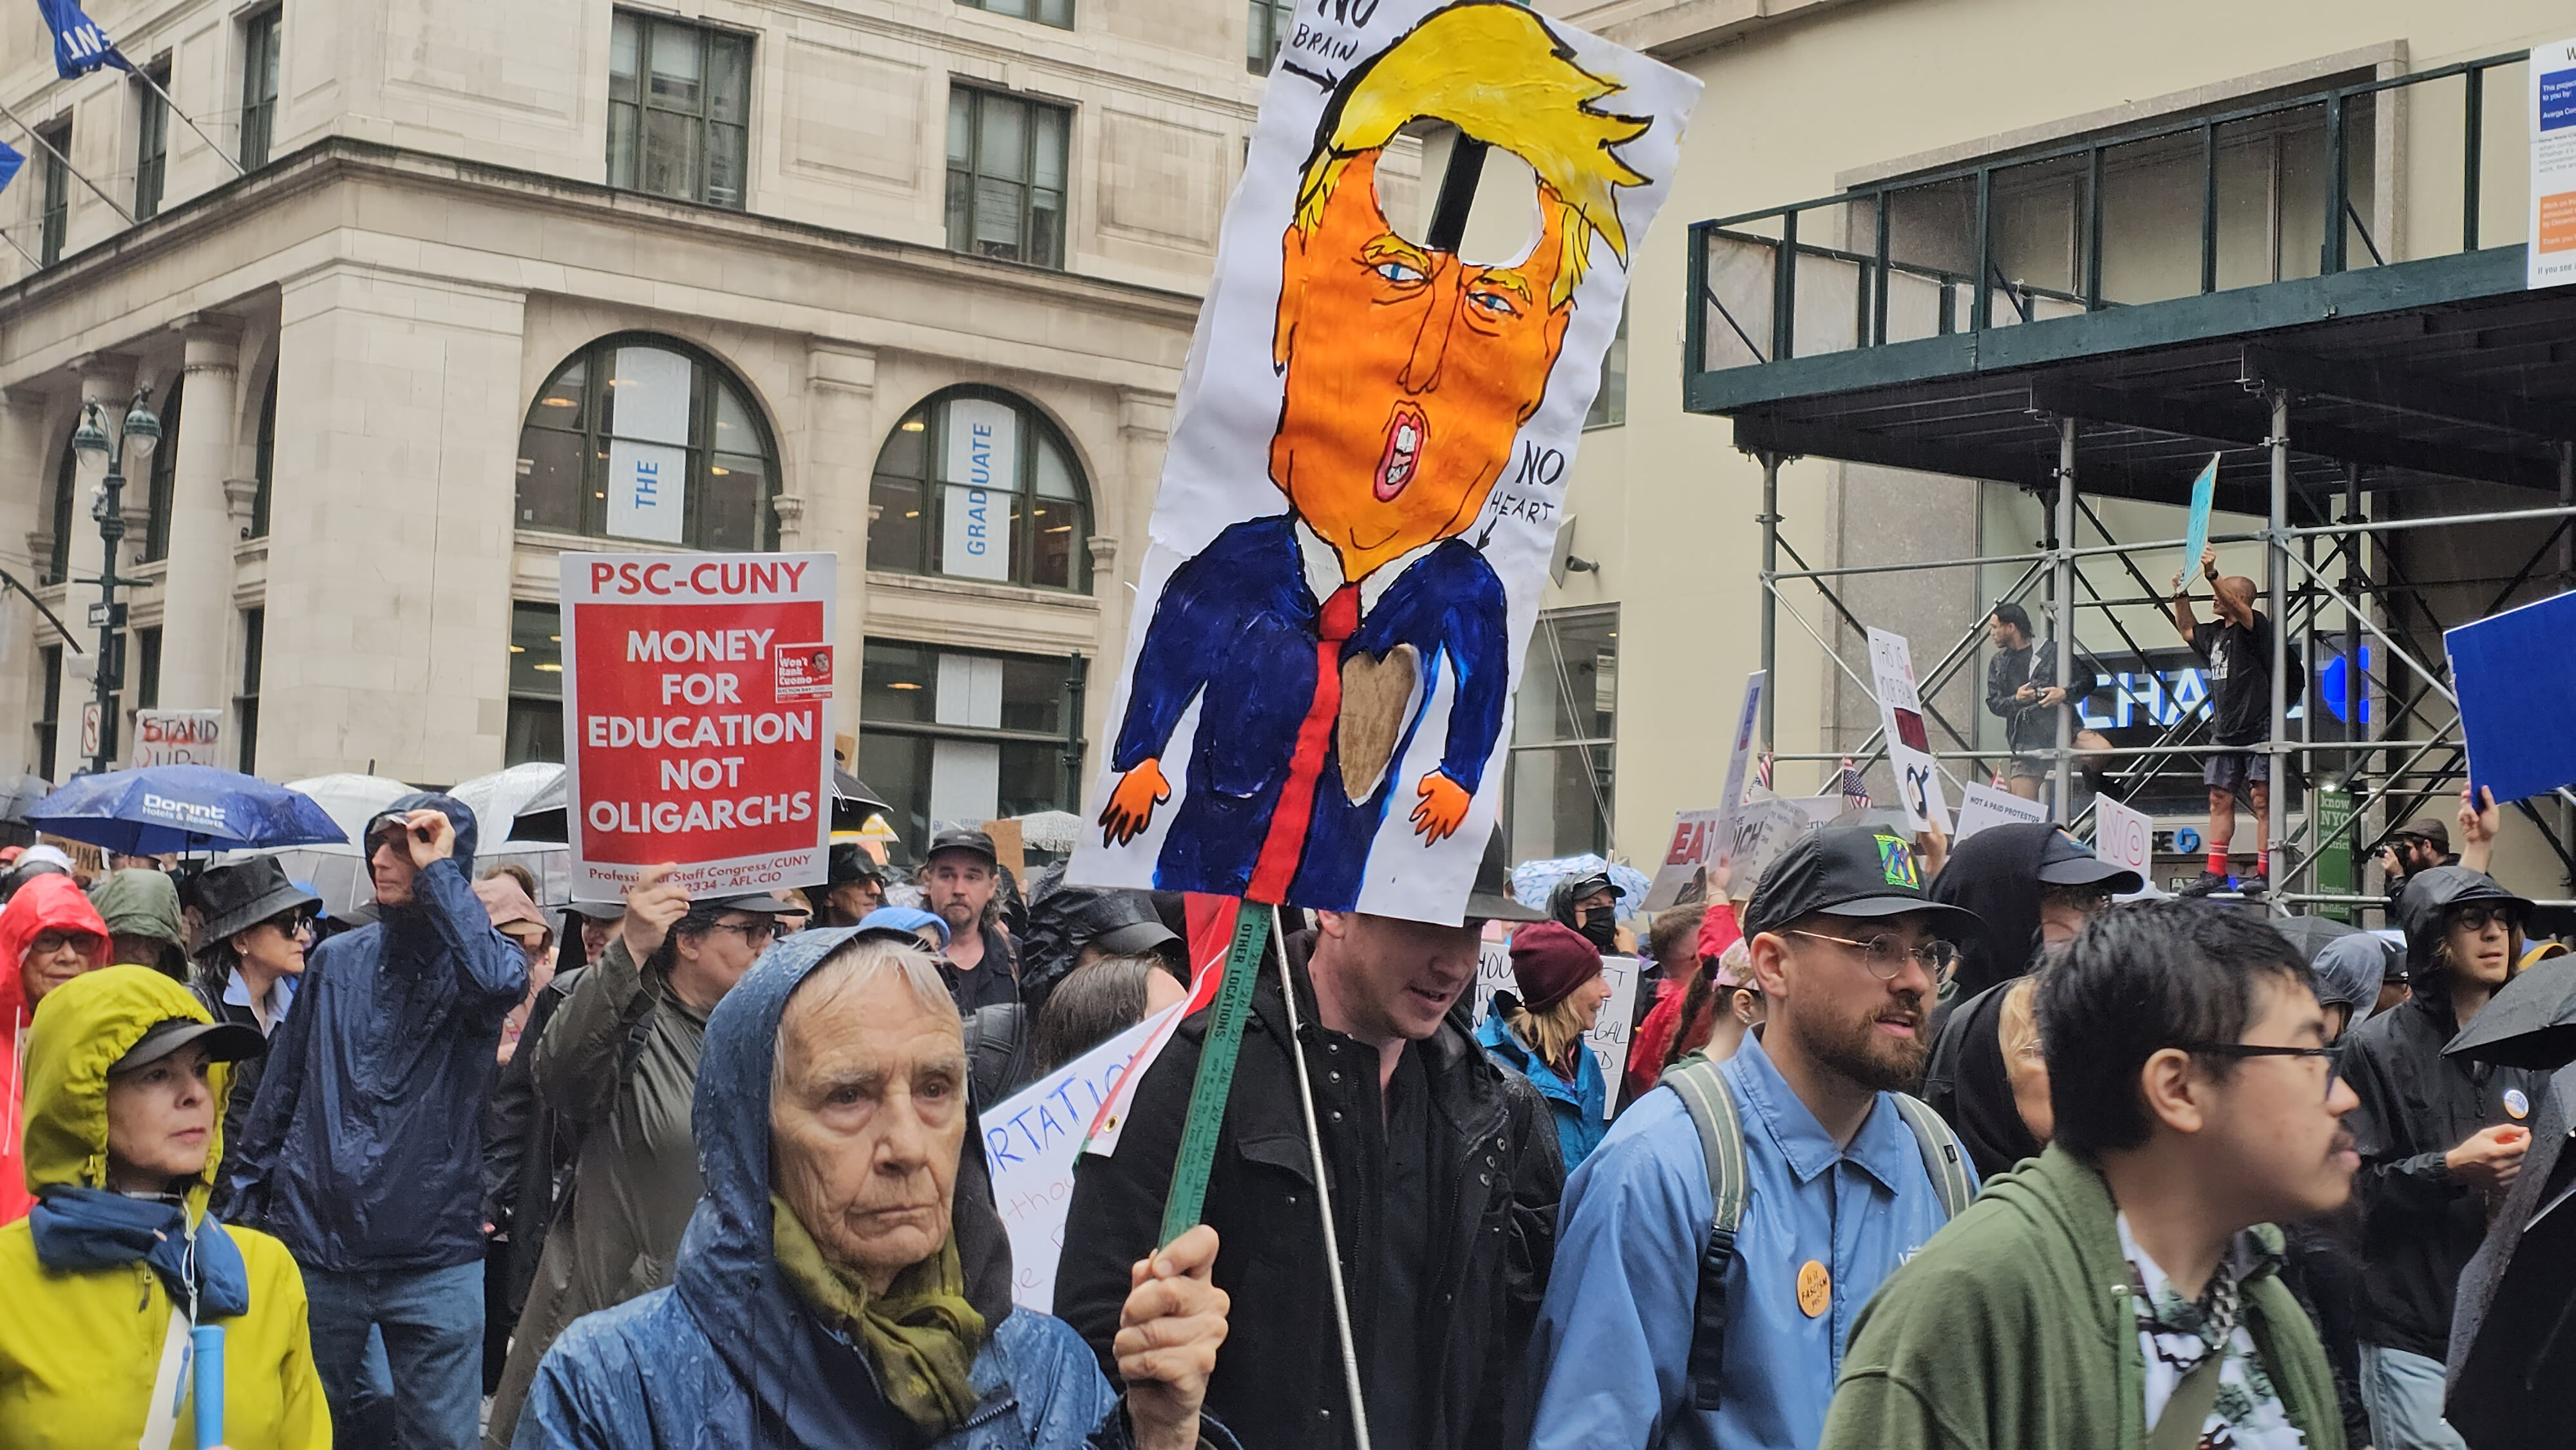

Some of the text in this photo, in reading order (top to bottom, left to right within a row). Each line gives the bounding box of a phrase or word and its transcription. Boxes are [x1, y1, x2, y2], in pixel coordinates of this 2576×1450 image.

[1292, 23, 1358, 62] BRAIN
[2545, 265, 2557, 275] you
[2560, 263, 2572, 272] see
[1515, 440, 1565, 485] NO
[636, 460, 658, 509] THE
[967, 423, 992, 556] GRADUATE
[1489, 490, 1554, 524] HEART
[591, 561, 809, 594] PSC-CUNY
[627, 629, 774, 663] MONEY
[779, 657, 808, 667] Won't
[662, 673, 741, 705] FOR
[779, 676, 812, 686] Cuomo
[142, 715, 218, 743] STAND
[588, 711, 811, 748] EDUCATION
[661, 757, 744, 790] NOT
[142, 805, 224, 829] Hotels & Resorts
[144, 793, 225, 820] Dorint
[589, 792, 811, 833] OLIGARCHS
[1970, 796, 1984, 806] NOT
[1989, 802, 2004, 813] PAID
[2004, 807, 2040, 823] PROTESTOR
[2320, 794, 2350, 809] know
[2102, 803, 2145, 866] NO
[674, 868, 706, 881] Staff
[708, 854, 811, 878] Congress/CUNY
[684, 880, 717, 892] 2334
[730, 871, 782, 887] AFL-CIO
[2320, 884, 2345, 894] Empire
[1215, 923, 1253, 1041] OTHER LOCATIONS:
